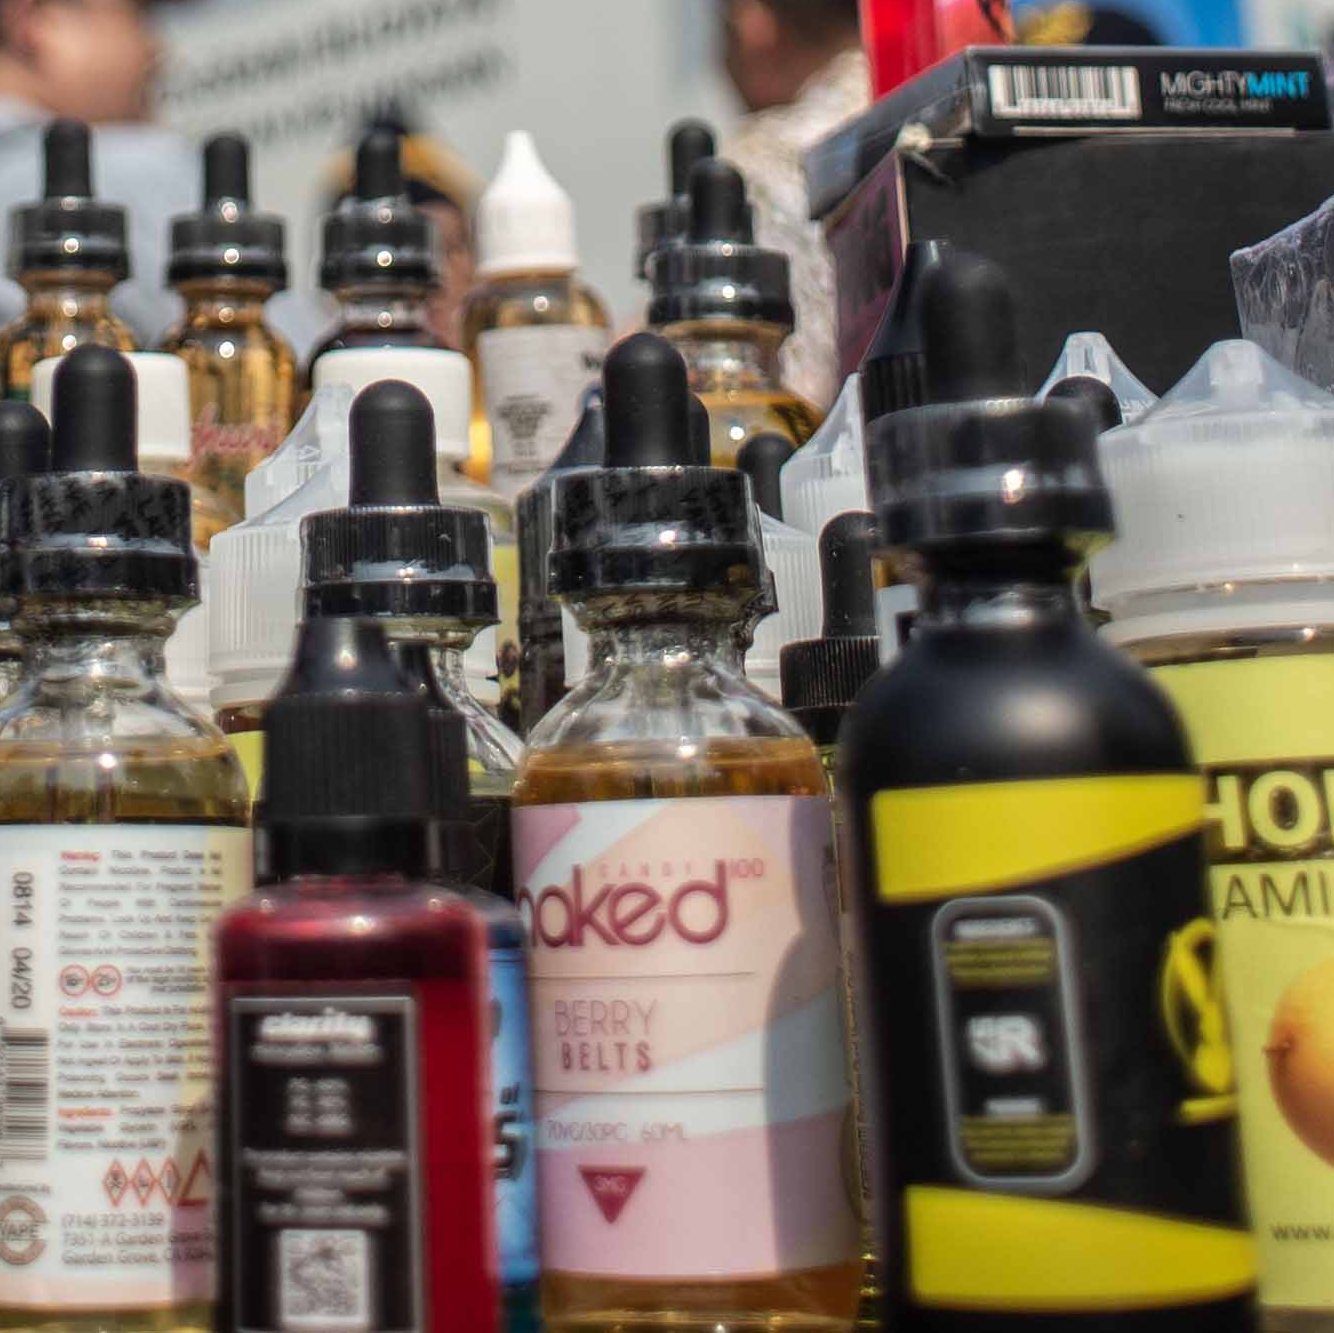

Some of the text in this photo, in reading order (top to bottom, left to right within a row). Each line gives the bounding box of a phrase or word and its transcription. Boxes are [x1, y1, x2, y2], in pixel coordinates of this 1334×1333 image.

[1221, 870, 1334, 920] AMI
[10, 870, 35, 1011] 0814 04/20
[554, 999, 658, 1037] BERRY
[561, 1042, 653, 1072] BELTS
